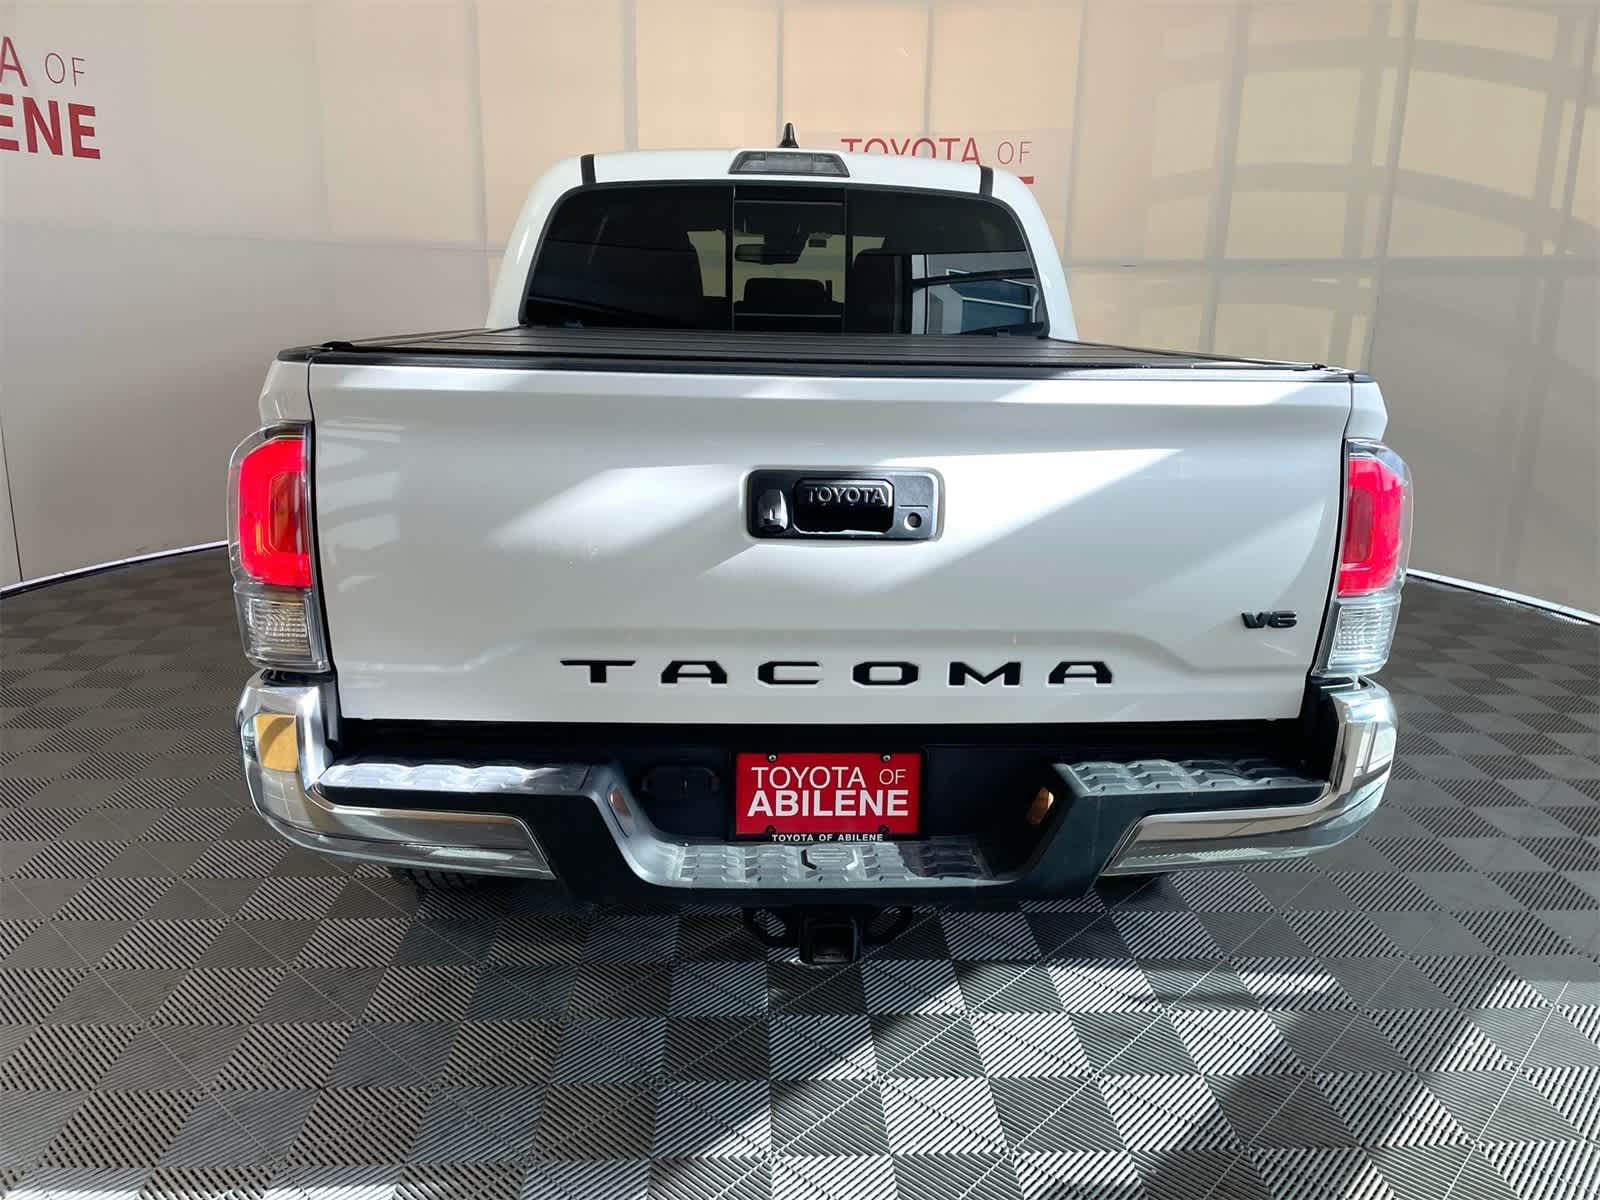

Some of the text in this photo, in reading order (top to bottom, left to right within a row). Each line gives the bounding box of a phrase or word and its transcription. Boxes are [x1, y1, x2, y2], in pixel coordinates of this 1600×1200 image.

[45, 52, 86, 87] OF
[997, 141, 1032, 165] OF
[807, 486, 888, 505] TOYOTA
[1241, 610, 1297, 629] V6
[560, 659, 1113, 686] TACOMA
[751, 766, 907, 789] TOYOTA OF
[747, 789, 909, 817] ABILENE
[772, 833, 884, 842] TOYOTA OF ABILENE
